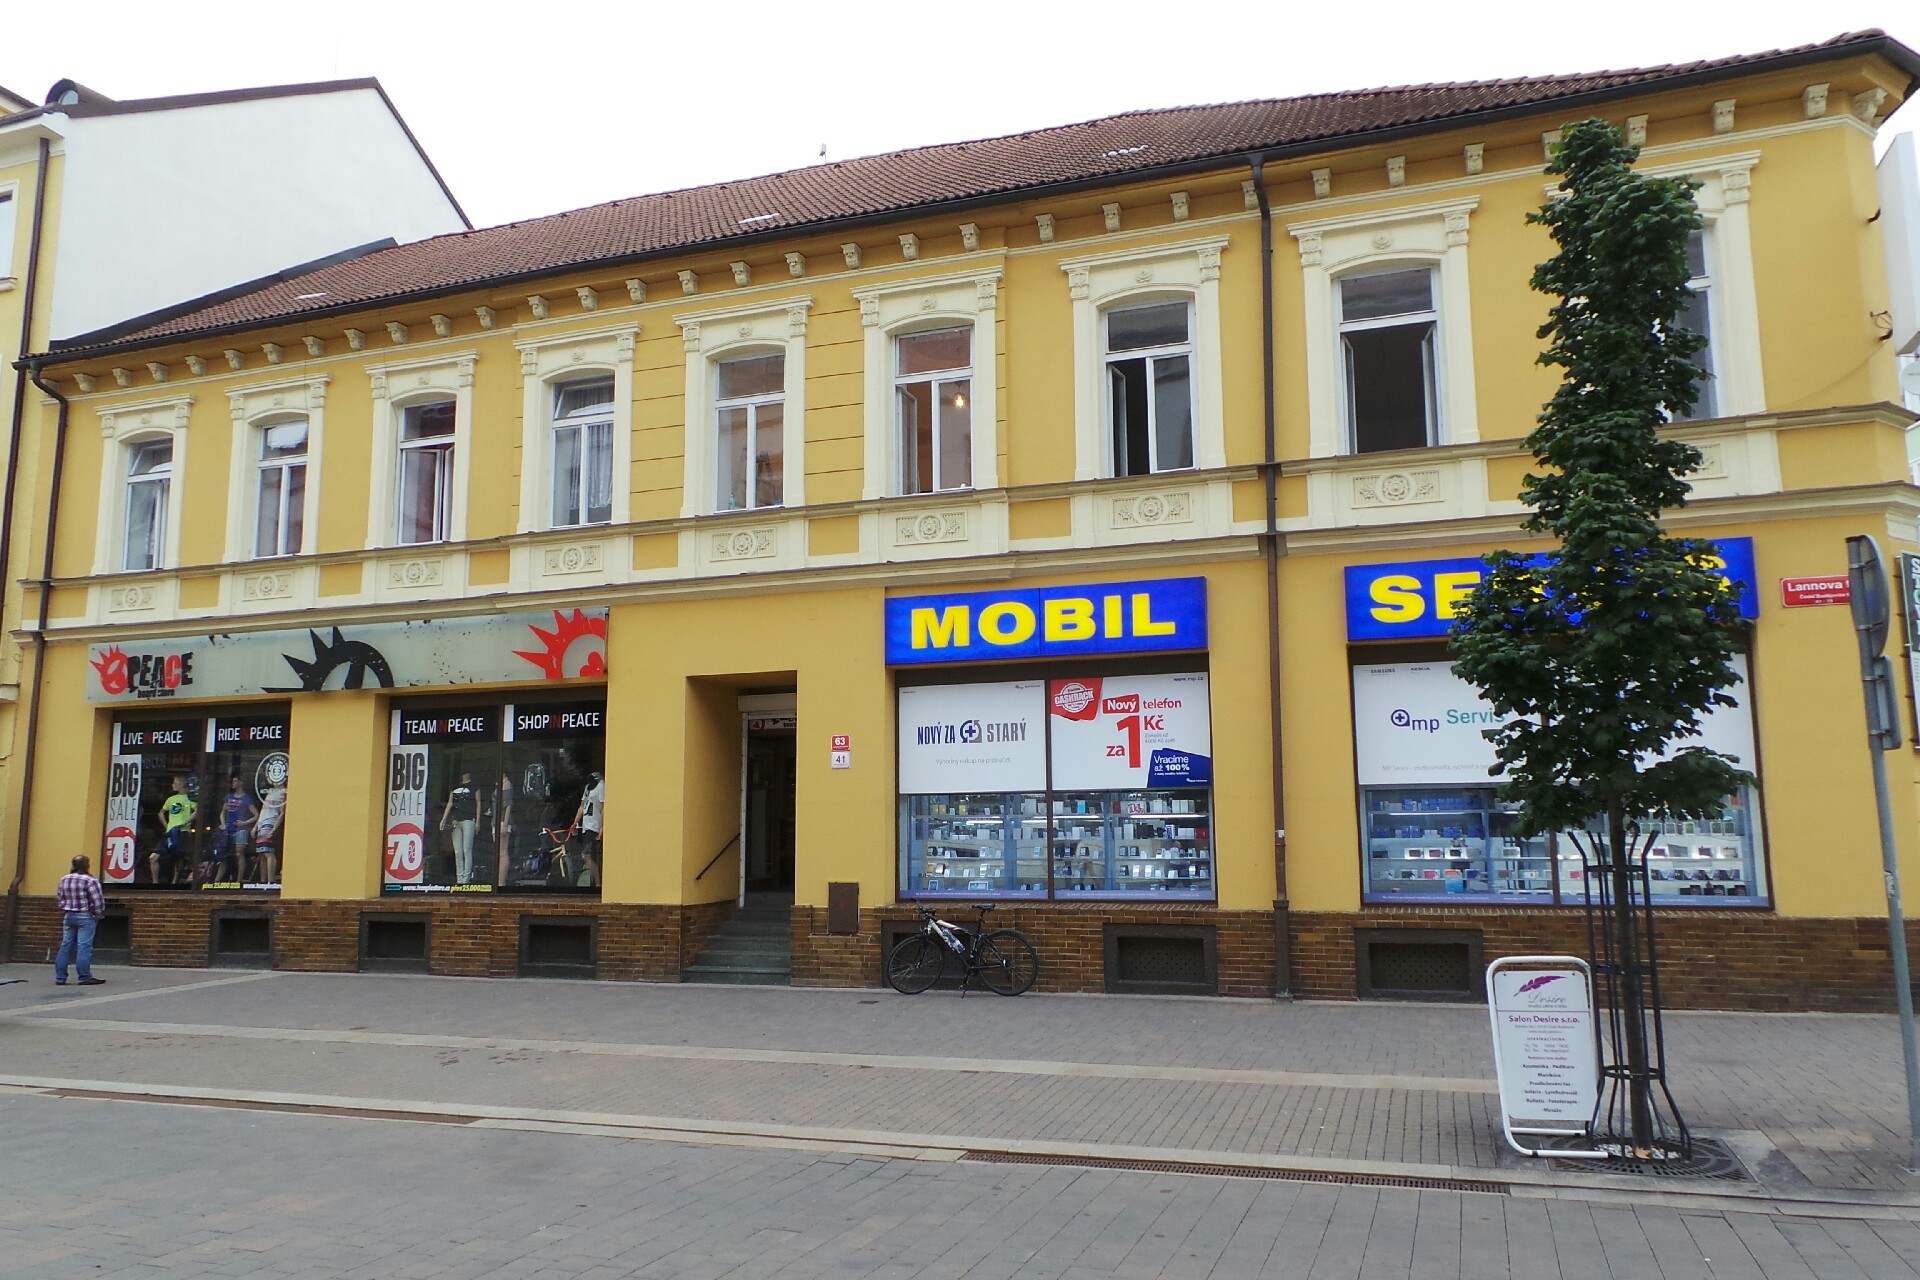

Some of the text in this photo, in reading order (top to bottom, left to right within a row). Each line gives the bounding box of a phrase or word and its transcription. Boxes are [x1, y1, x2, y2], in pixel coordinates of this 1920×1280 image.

[1787, 581, 1844, 592] Lannova
[911, 593, 1176, 650] MOBIL
[127, 652, 193, 693] PEACE
[1107, 698, 1182, 712] Nový telefon
[404, 719, 437, 734] TEAM
[447, 717, 484, 733] PEACE
[517, 714, 549, 730] SHOP
[561, 712, 600, 728] PEACE
[1412, 708, 1506, 733] mp Servis
[123, 732, 143, 746] LIVE
[152, 730, 183, 744] PEACE
[218, 727, 241, 741] RIDE
[249, 725, 282, 740] PEACE
[917, 717, 1027, 745] NOVÝ ZA STARÝ
[834, 737, 846, 746] 63
[1117, 714, 1164, 768] 1 Kč
[835, 755, 846, 764] 41
[1106, 745, 1125, 757] za
[1153, 754, 1189, 764] Vracíme
[391, 752, 425, 791] BIG
[1165, 763, 1190, 771] 100%
[111, 762, 139, 798] BIG
[109, 797, 137, 821] SALE
[389, 791, 423, 817] SALE
[1508, 1015, 1532, 1023] Salon
[1533, 1015, 1559, 1023] Desire
